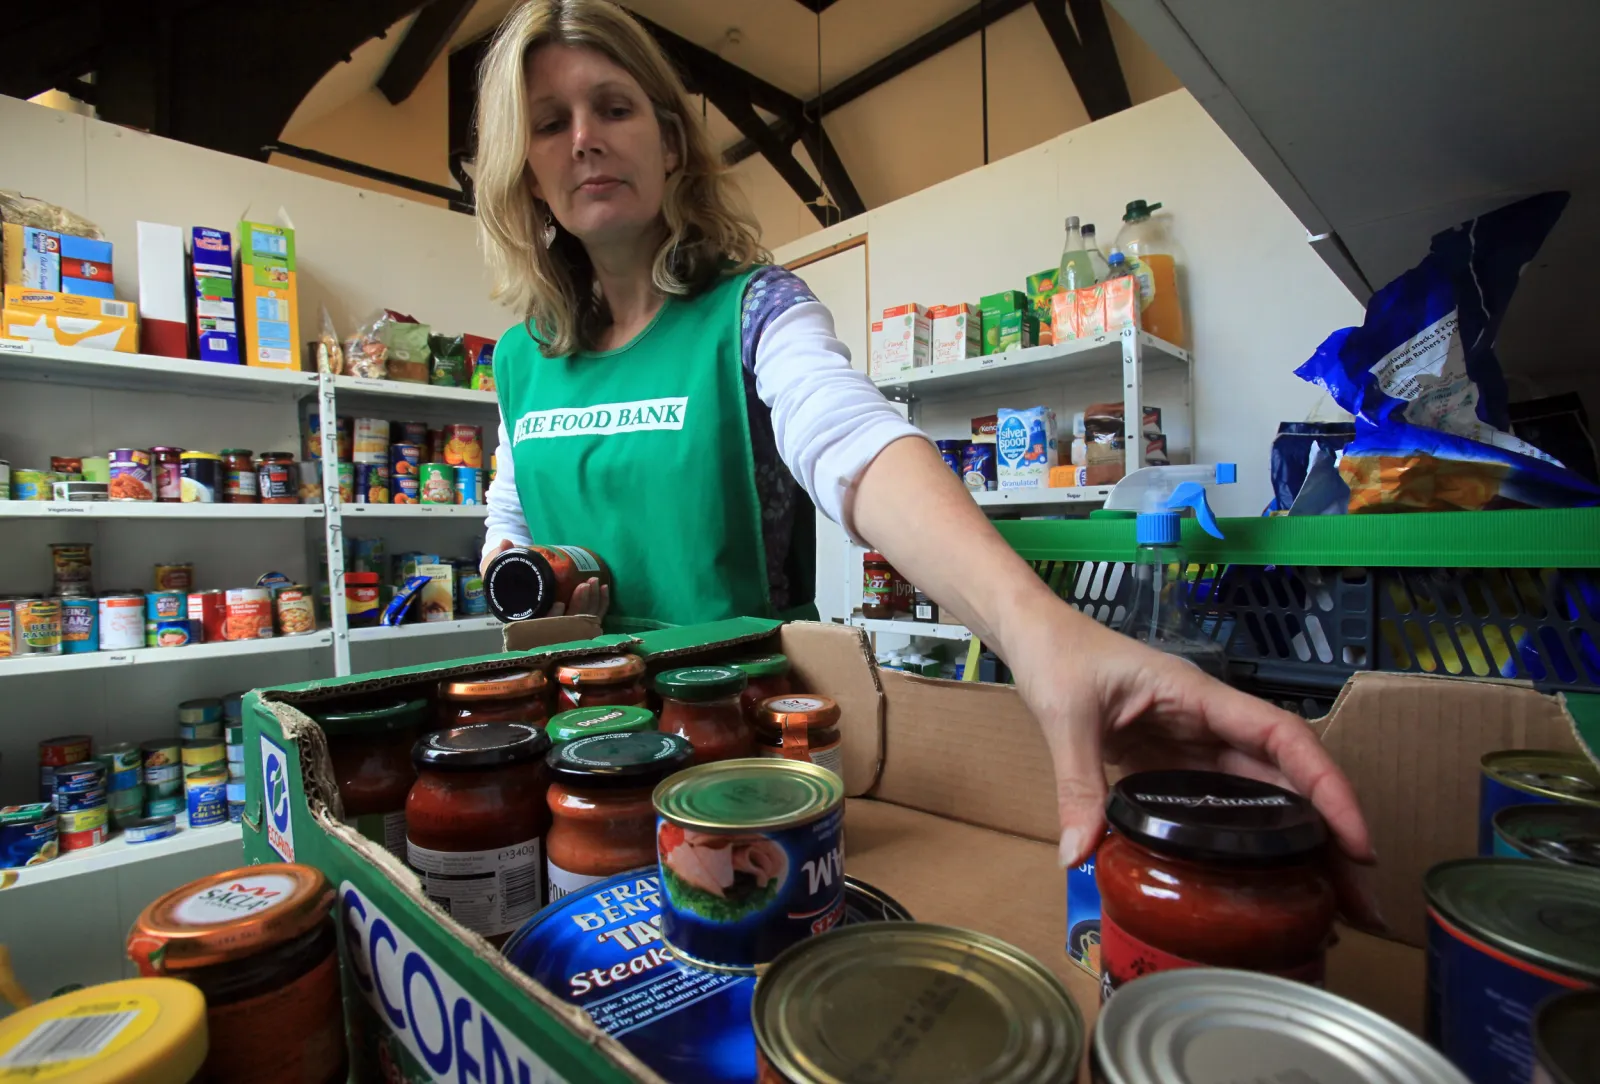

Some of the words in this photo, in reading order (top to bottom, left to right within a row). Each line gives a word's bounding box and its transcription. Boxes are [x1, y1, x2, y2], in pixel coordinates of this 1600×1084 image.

[1412, 334, 1434, 350] snacks
[1395, 356, 1414, 370] Bacon
[1413, 340, 1440, 358] Rashers
[549, 410, 612, 432] FOOD
[616, 404, 683, 427] BANK
[1000, 437, 1026, 449] spoon
[1001, 428, 1026, 440] silver
[1002, 478, 1038, 487] Granulated
[576, 711, 623, 727] DOLMIO
[1134, 793, 1190, 804] SEEDS
[1208, 796, 1292, 806] CHANGE
[509, 846, 535, 860] 340g
[572, 892, 660, 932] BENT
[570, 947, 674, 996] Steak
[602, 1001, 620, 1014] pie.
[618, 990, 648, 1006] Juicy
[650, 978, 678, 994] pieces
[616, 998, 655, 1016] covered
[674, 973, 714, 993] delicious
[620, 1016, 634, 1027] by
[635, 1009, 653, 1020] our
[654, 990, 699, 1011] signature
[699, 978, 720, 992] puff
